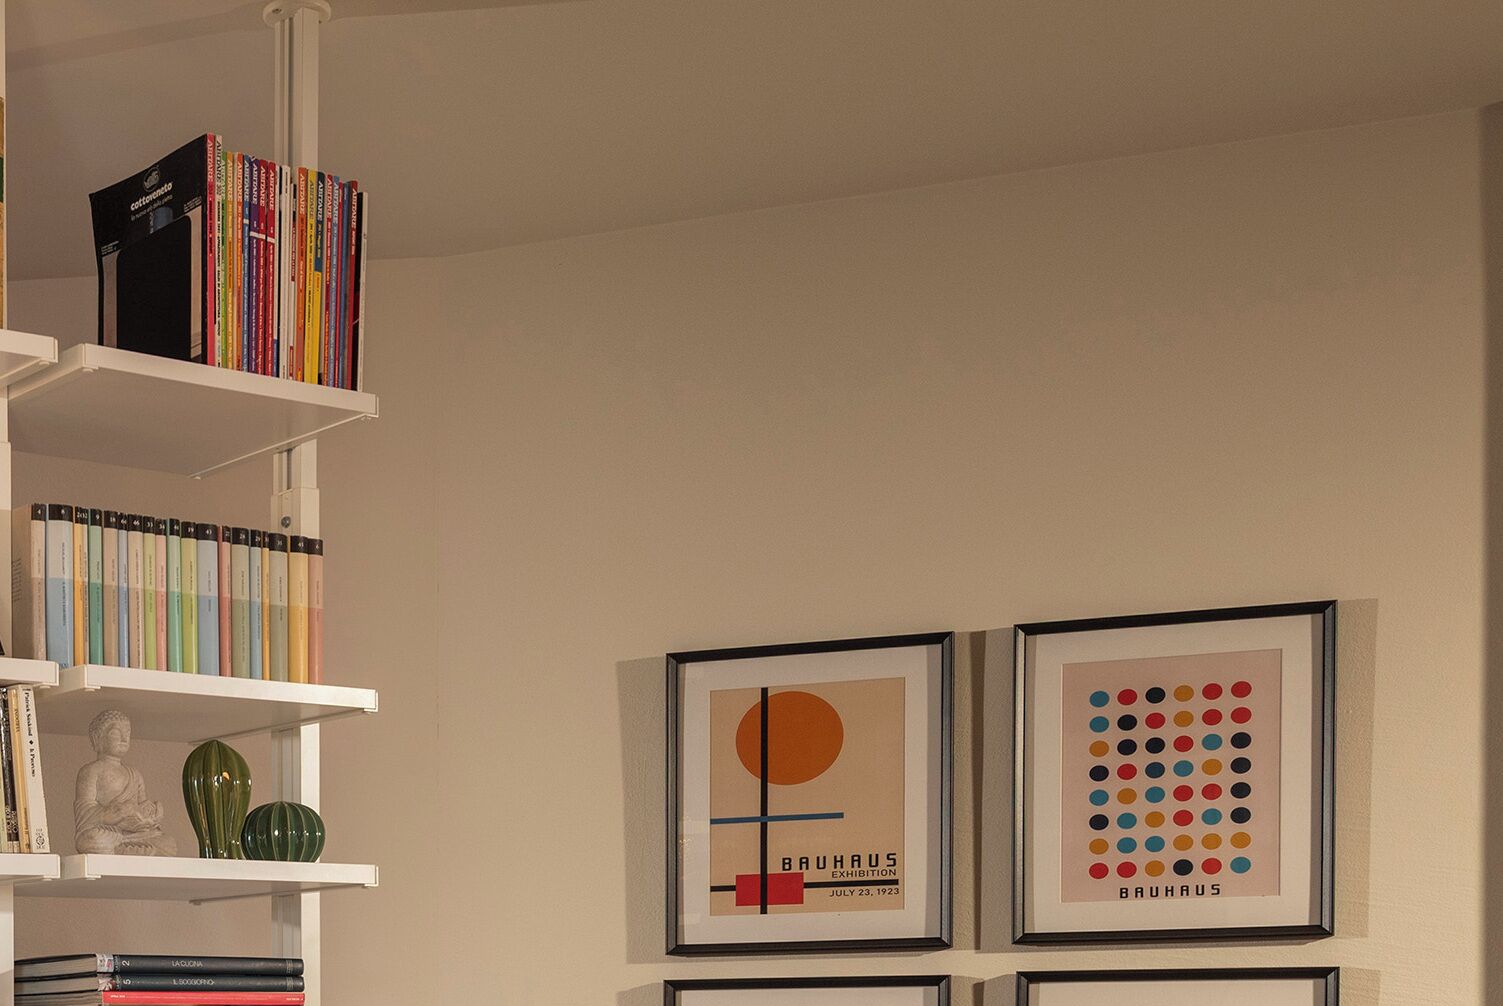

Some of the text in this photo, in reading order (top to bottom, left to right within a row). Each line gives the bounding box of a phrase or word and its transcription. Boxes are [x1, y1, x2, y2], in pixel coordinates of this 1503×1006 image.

[781, 853, 897, 872] BAUHAUS
[831, 868, 896, 879] EXHIBITION
[829, 887, 900, 898] JULY 23, 1923
[1119, 883, 1221, 899] BAUHAUS
[123, 976, 132, 985] 5
